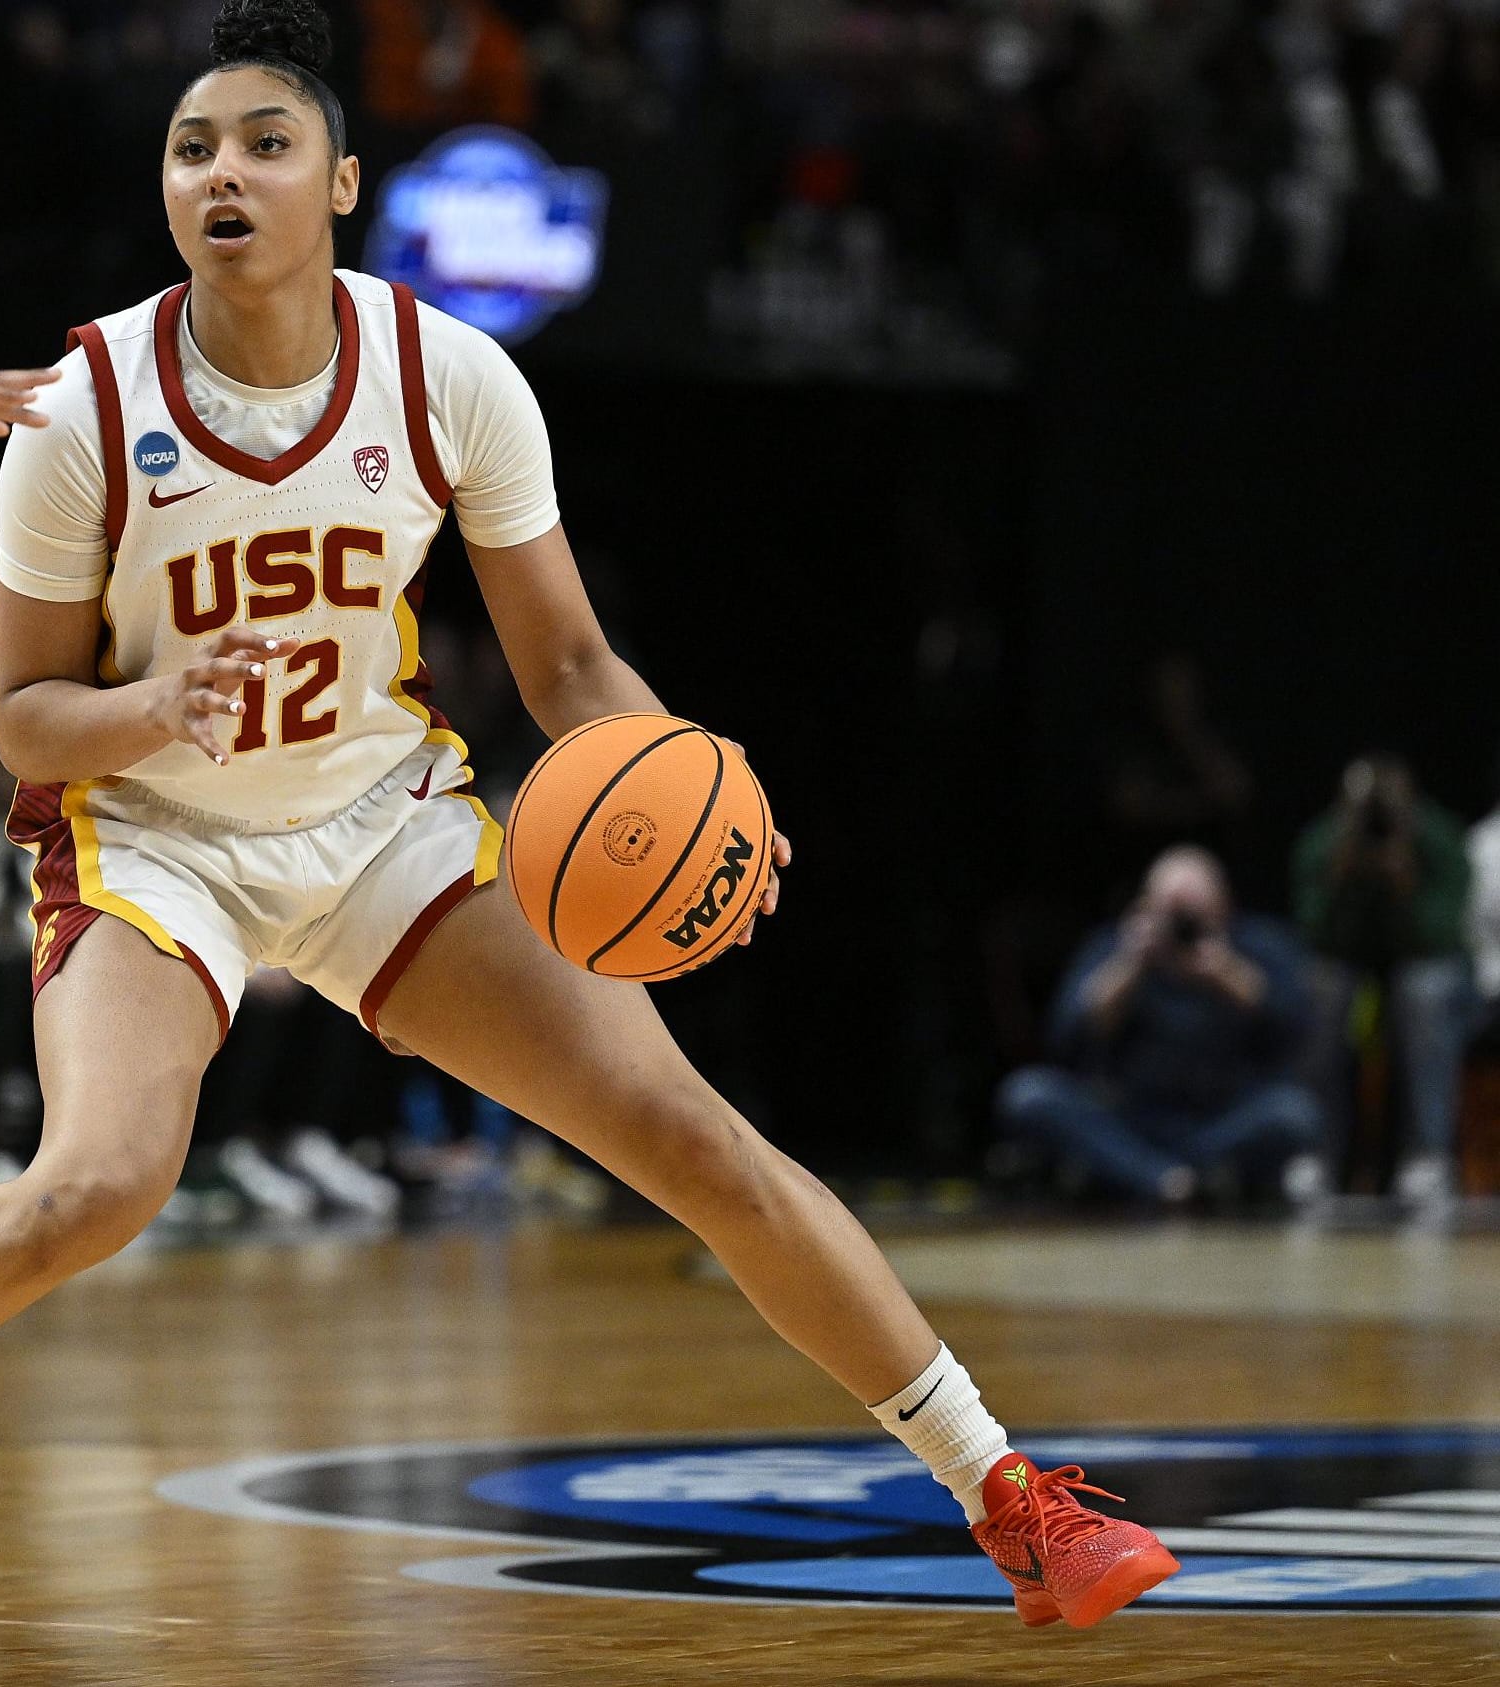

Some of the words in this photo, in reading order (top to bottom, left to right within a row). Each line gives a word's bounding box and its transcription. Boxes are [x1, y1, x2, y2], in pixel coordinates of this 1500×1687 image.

[141, 451, 176, 465] NCAA
[355, 450, 388, 473] PAC
[364, 465, 382, 483] 12
[165, 525, 386, 637] USC
[231, 637, 342, 755] 12
[706, 820, 729, 871] OFFICIAL
[662, 826, 754, 949] NCAA
[683, 874, 707, 906] GAME
[655, 908, 683, 931] BALL
